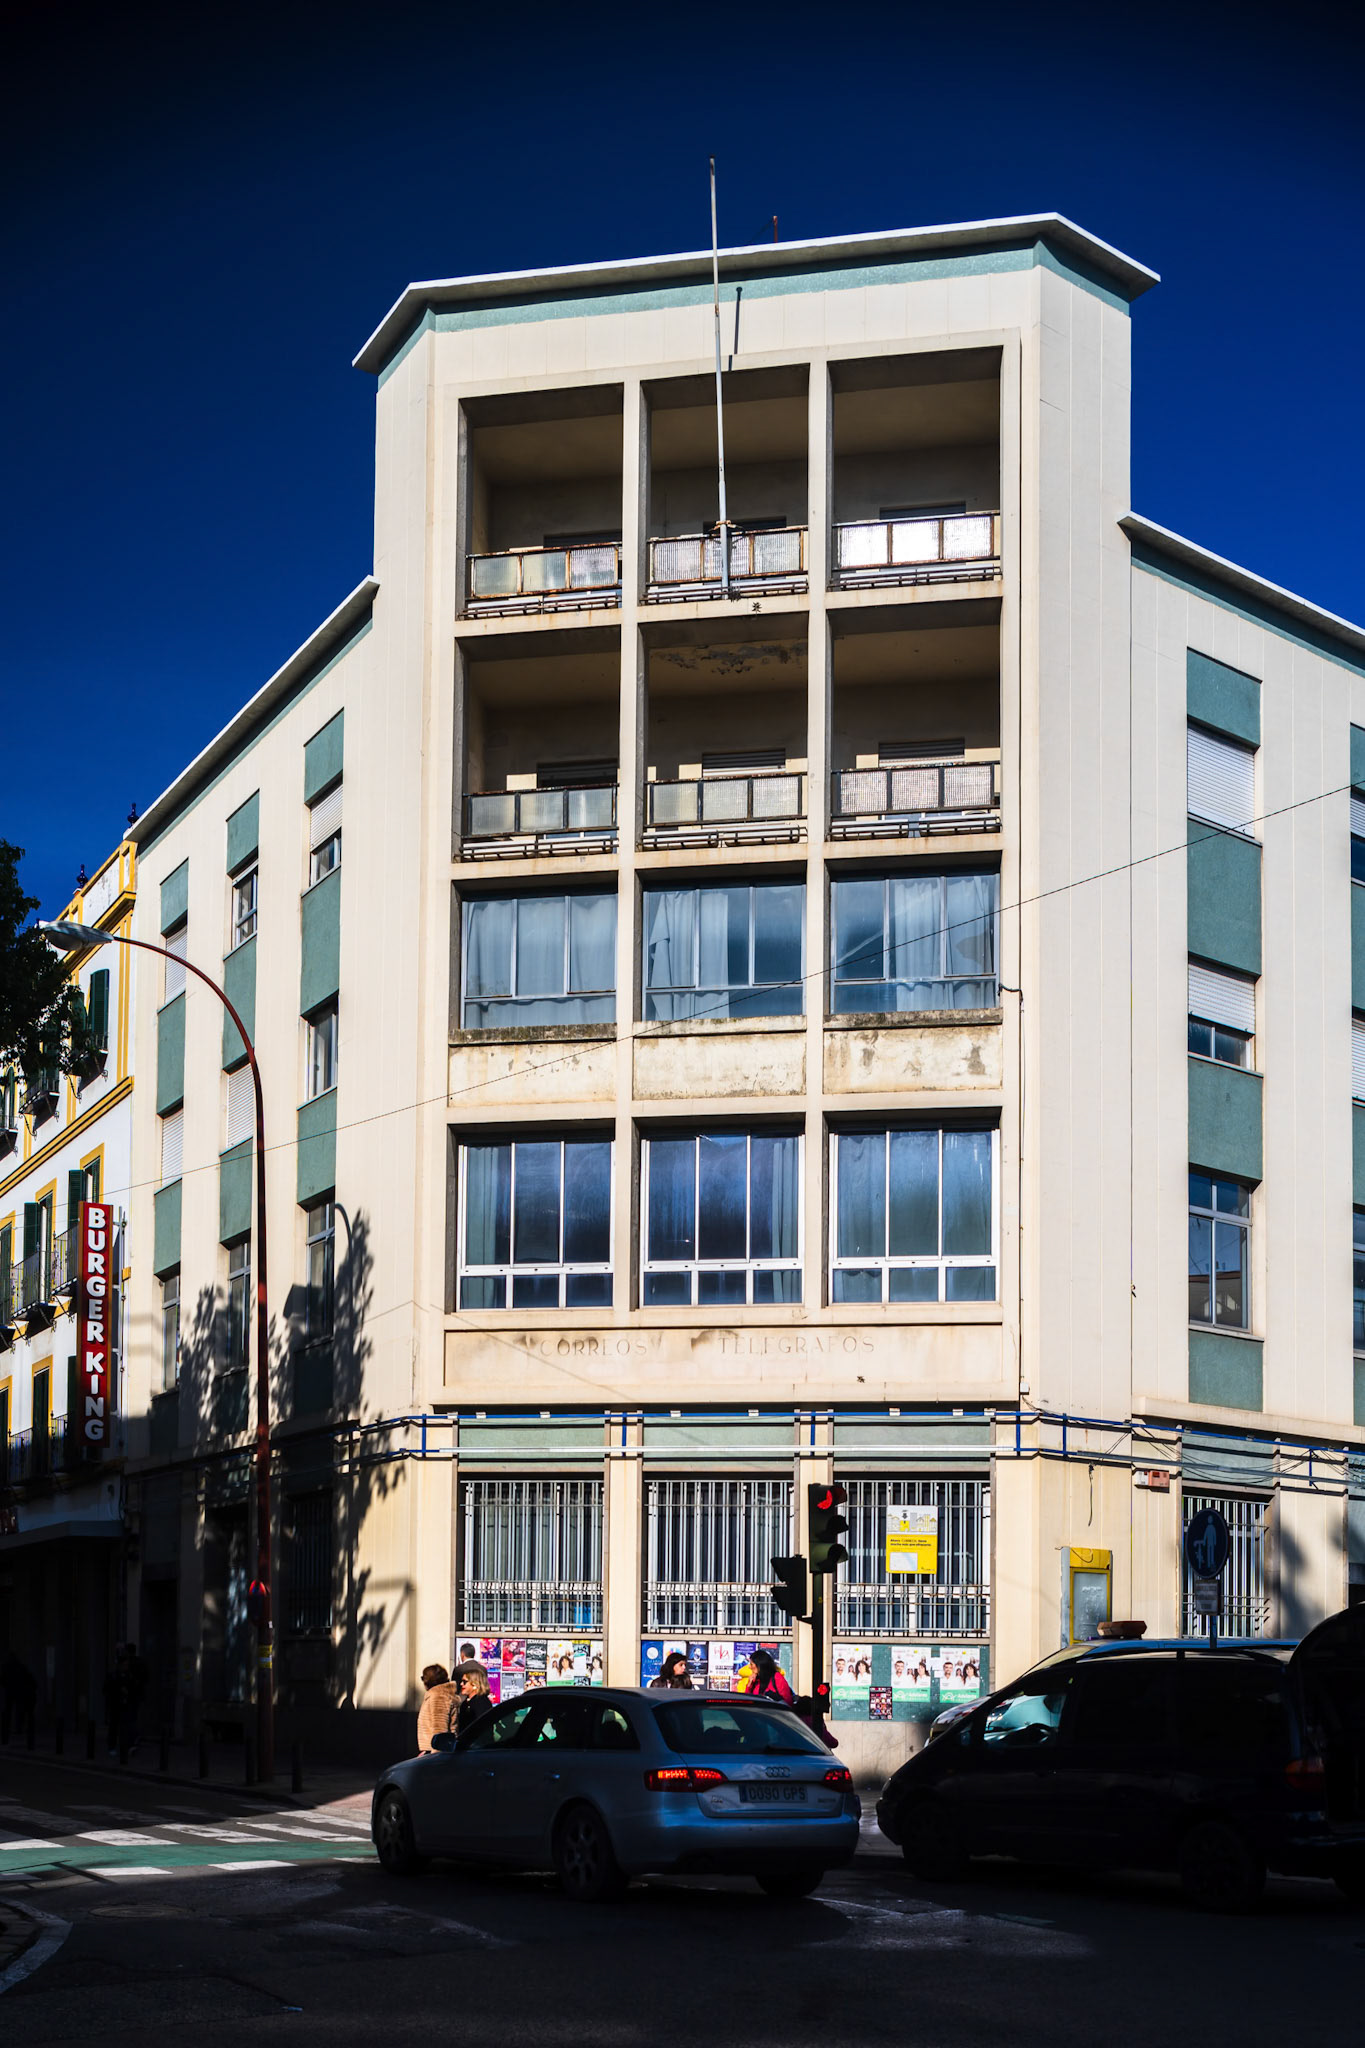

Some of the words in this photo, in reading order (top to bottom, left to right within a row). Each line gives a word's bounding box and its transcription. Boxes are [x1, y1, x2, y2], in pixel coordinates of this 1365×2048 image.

[86, 1207, 106, 1343] BURGER
[540, 1336, 647, 1357] CORREOS
[718, 1335, 875, 1355] TELEGRAFOS
[84, 1352, 104, 1441] KING
[750, 1786, 780, 1801] 0090
[783, 1785, 806, 1800] GPS
